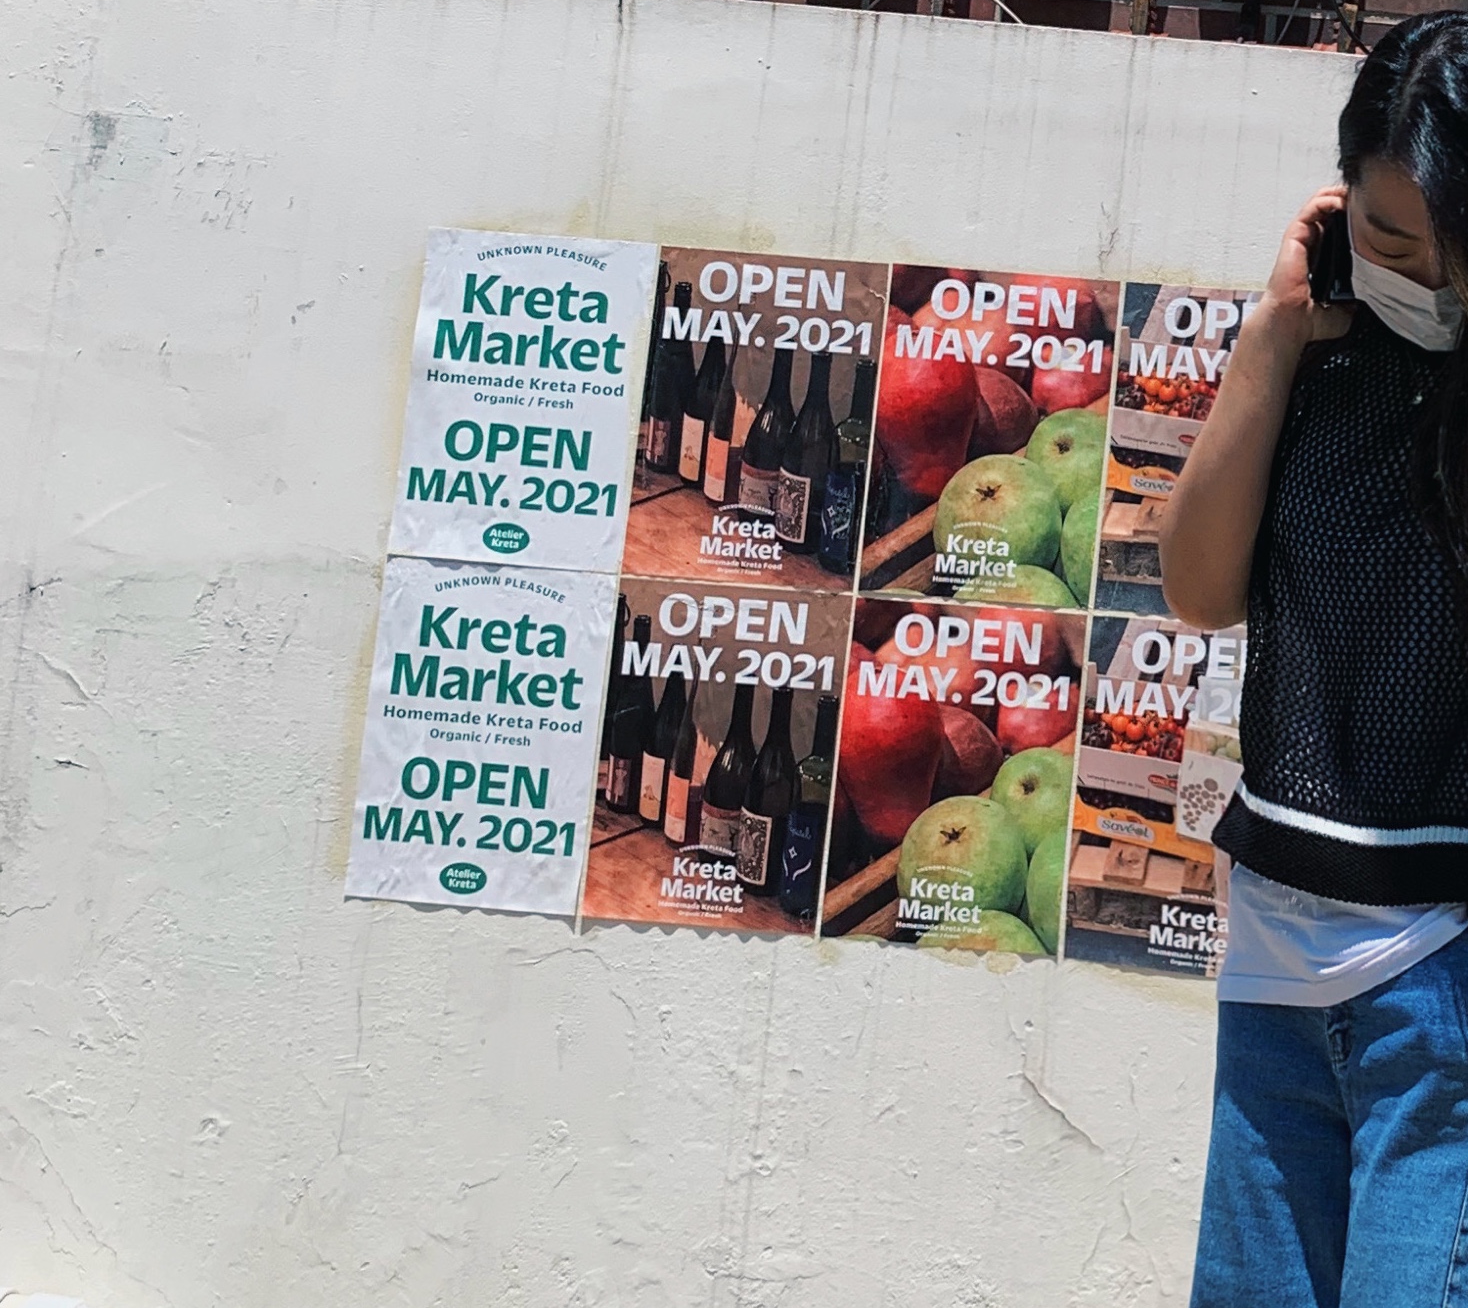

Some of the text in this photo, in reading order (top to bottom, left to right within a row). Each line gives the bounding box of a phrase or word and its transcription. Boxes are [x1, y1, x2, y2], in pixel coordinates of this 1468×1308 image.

[477, 245, 607, 272] UNKNOWN PLEASURE
[461, 273, 609, 324] Kreta
[700, 261, 846, 312] OPEN
[930, 279, 1078, 330] OPEN
[1164, 297, 1258, 339] OP
[433, 318, 625, 374] Market
[661, 307, 873, 356] MAY. 2021
[894, 324, 1104, 375] MAY. 2021
[1129, 342, 1227, 382] MAY
[426, 369, 625, 397] Homemade Kreta Food
[473, 392, 525, 408] Organic
[538, 396, 574, 410] Fresh
[444, 419, 593, 472] OPEN
[406, 466, 618, 518] MAY. 2021
[489, 527, 525, 541] Atelier
[712, 515, 776, 539] Kreta
[490, 537, 520, 550] Kreta
[700, 535, 783, 561] Market
[946, 533, 1009, 557] Kreta
[935, 553, 1017, 578] Market
[435, 576, 566, 604] UNKNOWN PLEASURE
[419, 605, 567, 659] Kreta
[659, 593, 807, 645] OPEN
[894, 612, 1043, 666] OPEN
[621, 640, 835, 691] MAY. 2021
[1131, 630, 1248, 680] OPE
[390, 653, 583, 711] Market
[856, 660, 1070, 712] MAY. 2021
[383, 704, 582, 734] Homemade Kreta Food
[429, 728, 481, 744] Organic
[495, 732, 531, 747] Fresh
[401, 756, 549, 810] OPEN
[362, 805, 576, 857] MAY. 2021
[446, 867, 482, 881] Atelier
[447, 877, 477, 890] Kreta
[672, 856, 736, 881] Kreta
[660, 877, 744, 904] Market
[910, 877, 975, 902] Kreta
[898, 898, 982, 924] Market
[1161, 904, 1229, 934] Kreta
[1149, 924, 1228, 954] Marke
